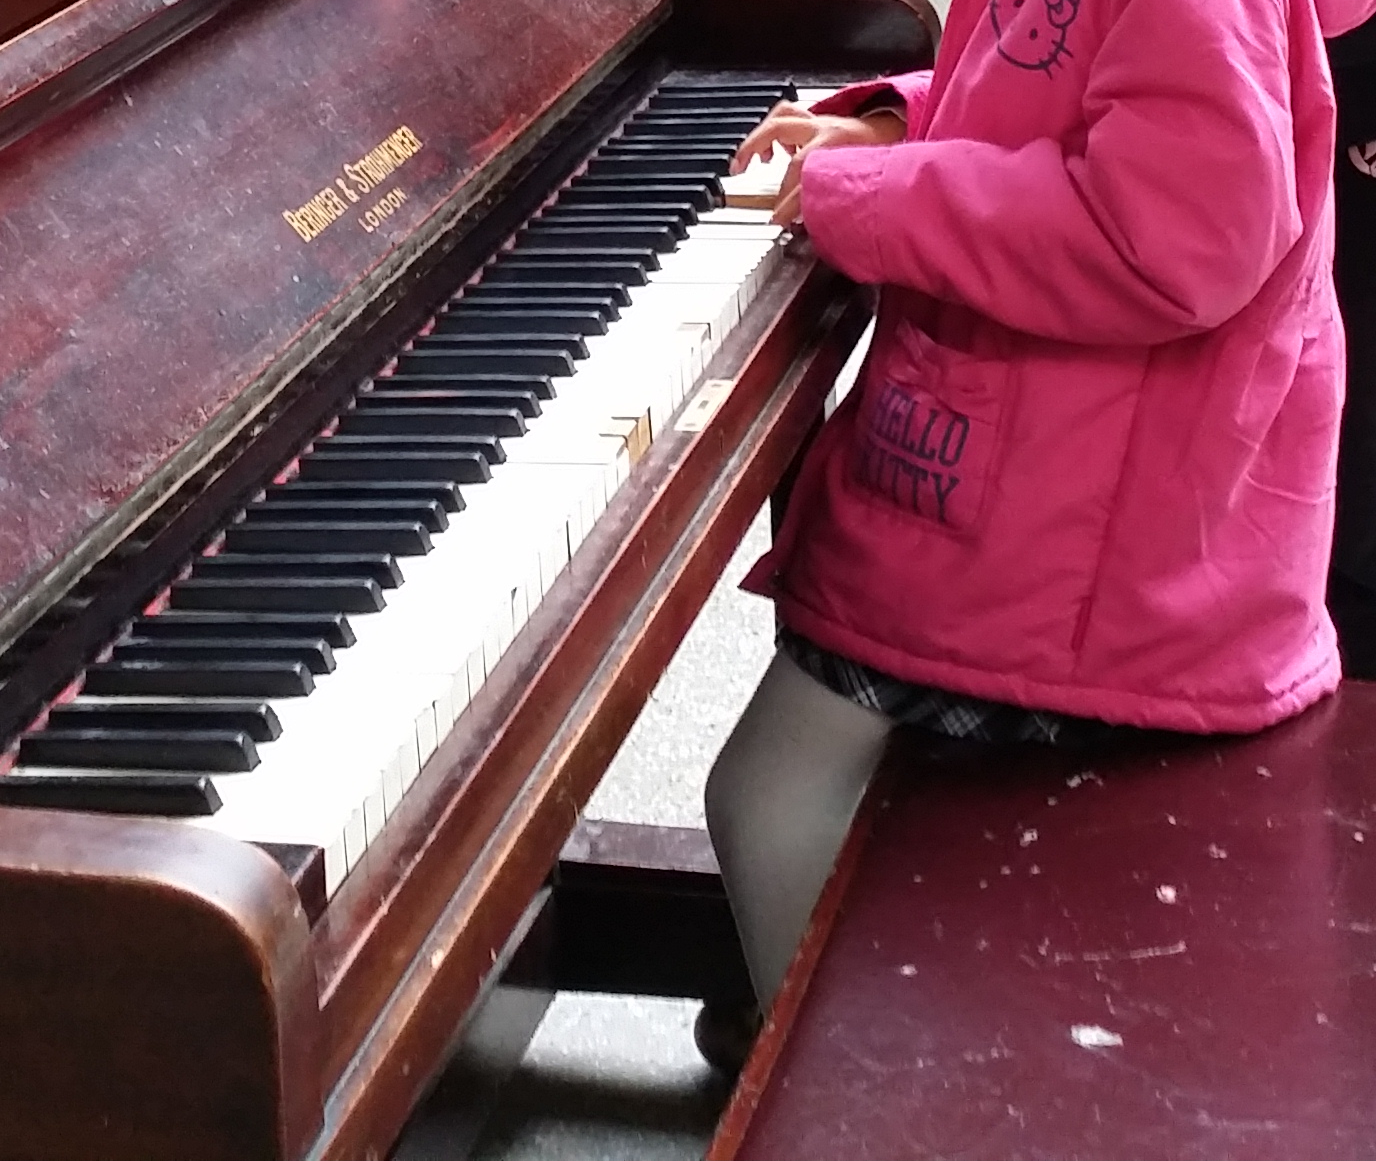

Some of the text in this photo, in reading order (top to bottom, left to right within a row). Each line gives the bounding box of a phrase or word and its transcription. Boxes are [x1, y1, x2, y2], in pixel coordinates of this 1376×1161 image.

[335, 177, 361, 203] &
[358, 186, 408, 233] LONDON
[870, 379, 970, 467] HELLO
